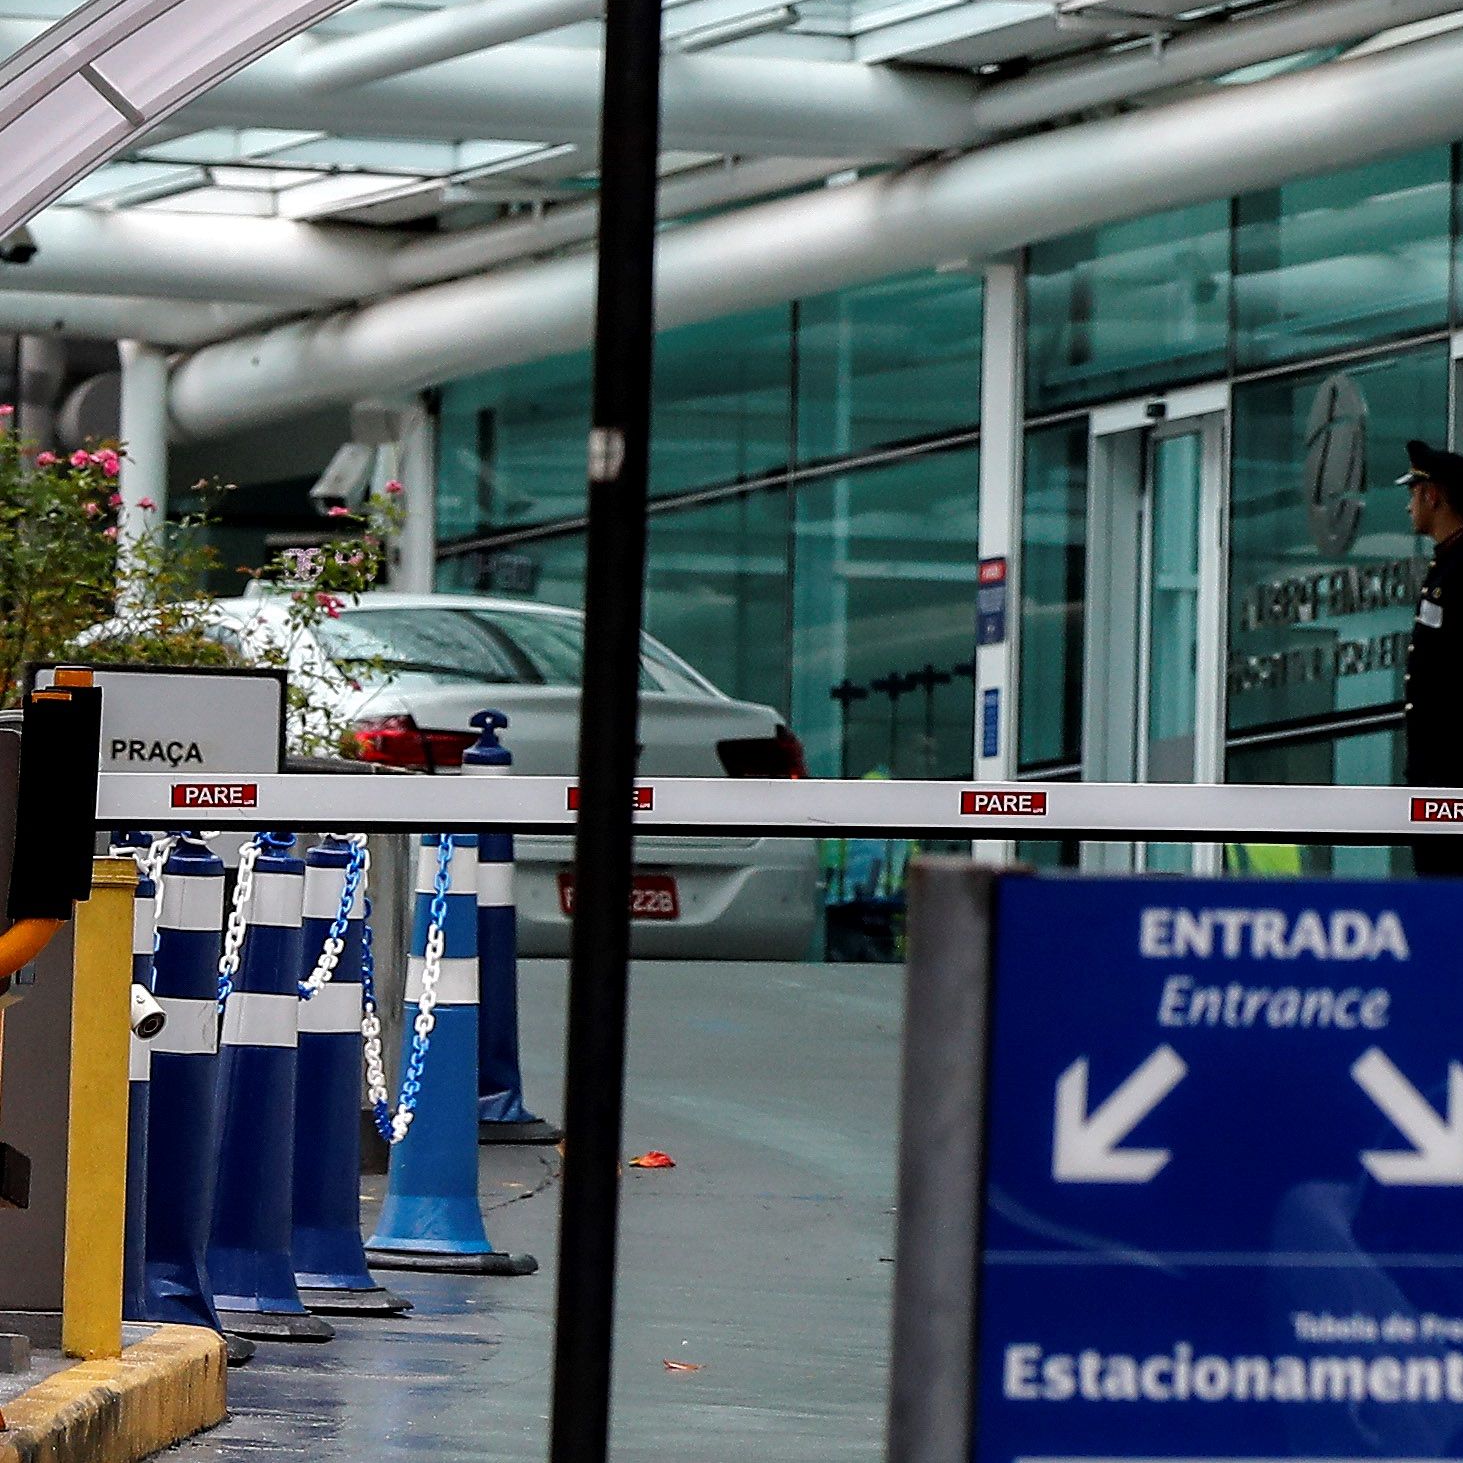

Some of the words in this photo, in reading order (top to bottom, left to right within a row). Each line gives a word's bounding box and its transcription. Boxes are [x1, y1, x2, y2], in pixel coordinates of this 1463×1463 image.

[111, 740, 203, 767] PRAÇA
[185, 787, 243, 804] PARE
[975, 795, 1032, 812] PARE
[1139, 909, 1408, 960] ENTRADA
[1157, 977, 1391, 1028] Entrance
